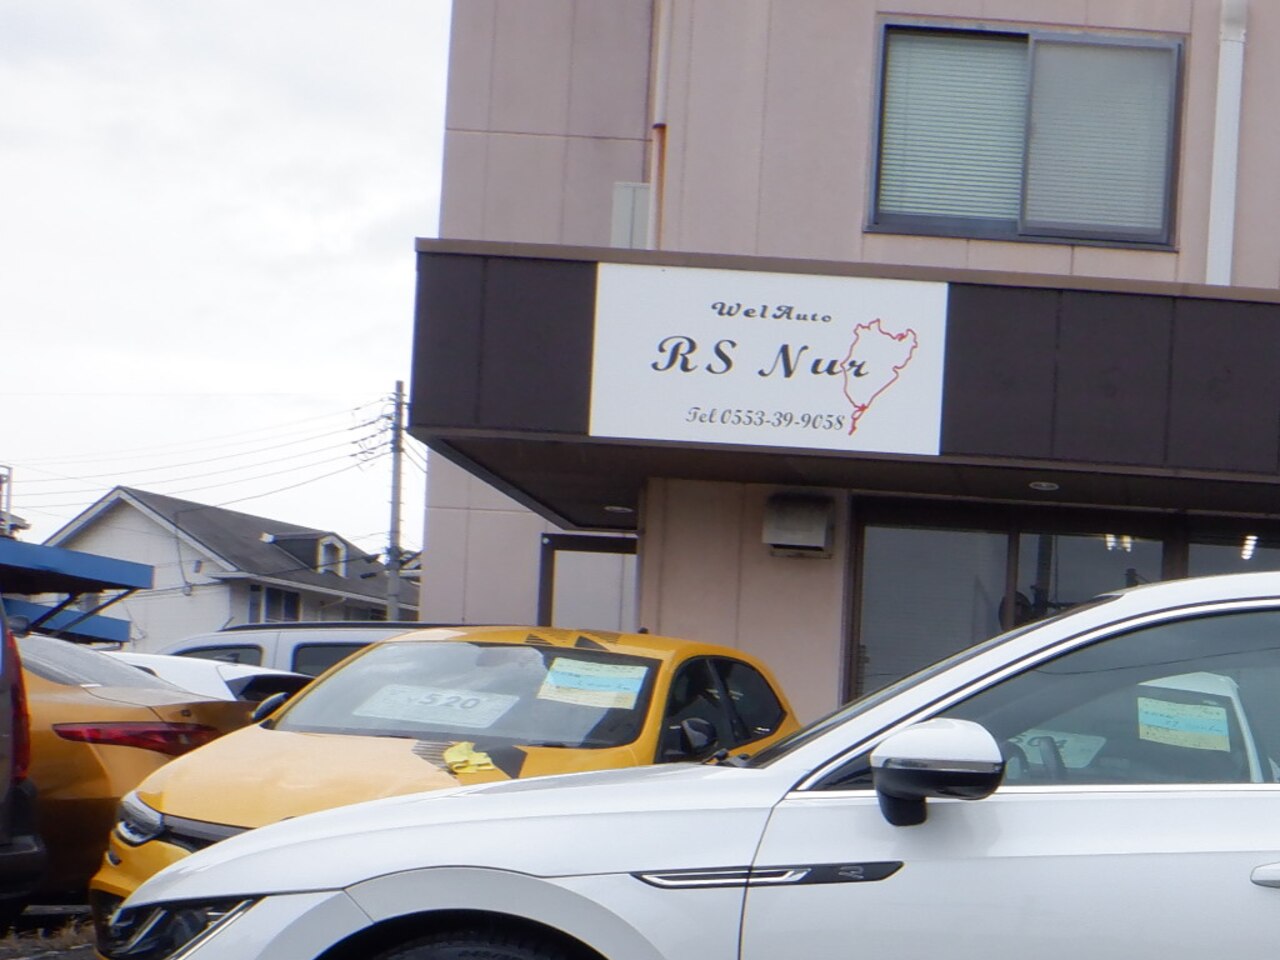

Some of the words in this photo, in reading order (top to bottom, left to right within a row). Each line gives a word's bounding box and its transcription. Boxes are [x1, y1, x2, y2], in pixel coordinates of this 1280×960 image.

[651, 335, 737, 375] RS
[757, 343, 869, 379] Nur
[686, 406, 717, 424] Tel
[720, 408, 846, 431] 0553-39-9058
